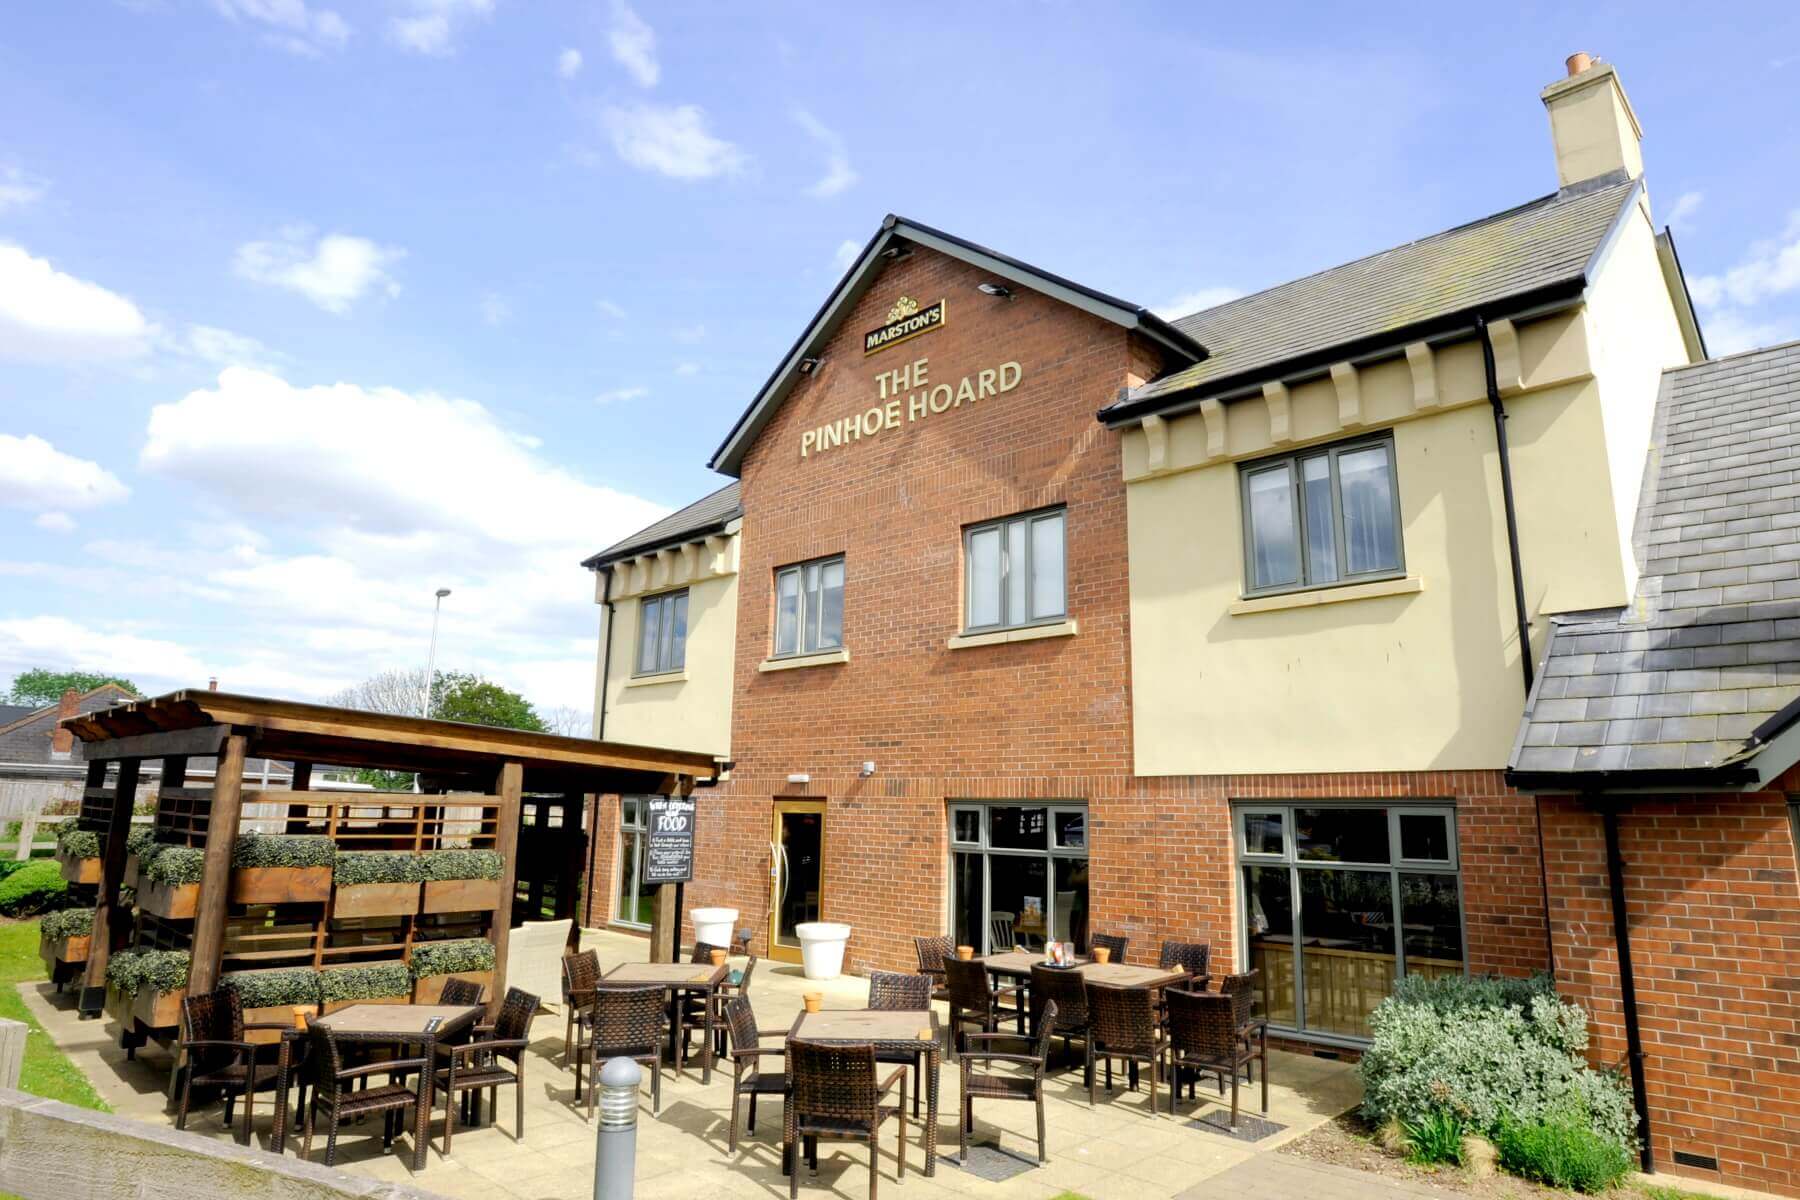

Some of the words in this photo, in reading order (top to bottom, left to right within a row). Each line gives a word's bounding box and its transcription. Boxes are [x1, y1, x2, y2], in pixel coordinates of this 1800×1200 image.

[866, 308, 940, 349] MARSTON'S
[875, 358, 929, 399] THE
[801, 401, 901, 457] PINHOE
[908, 361, 1022, 421] HOARD
[658, 816, 687, 831] FOOD
